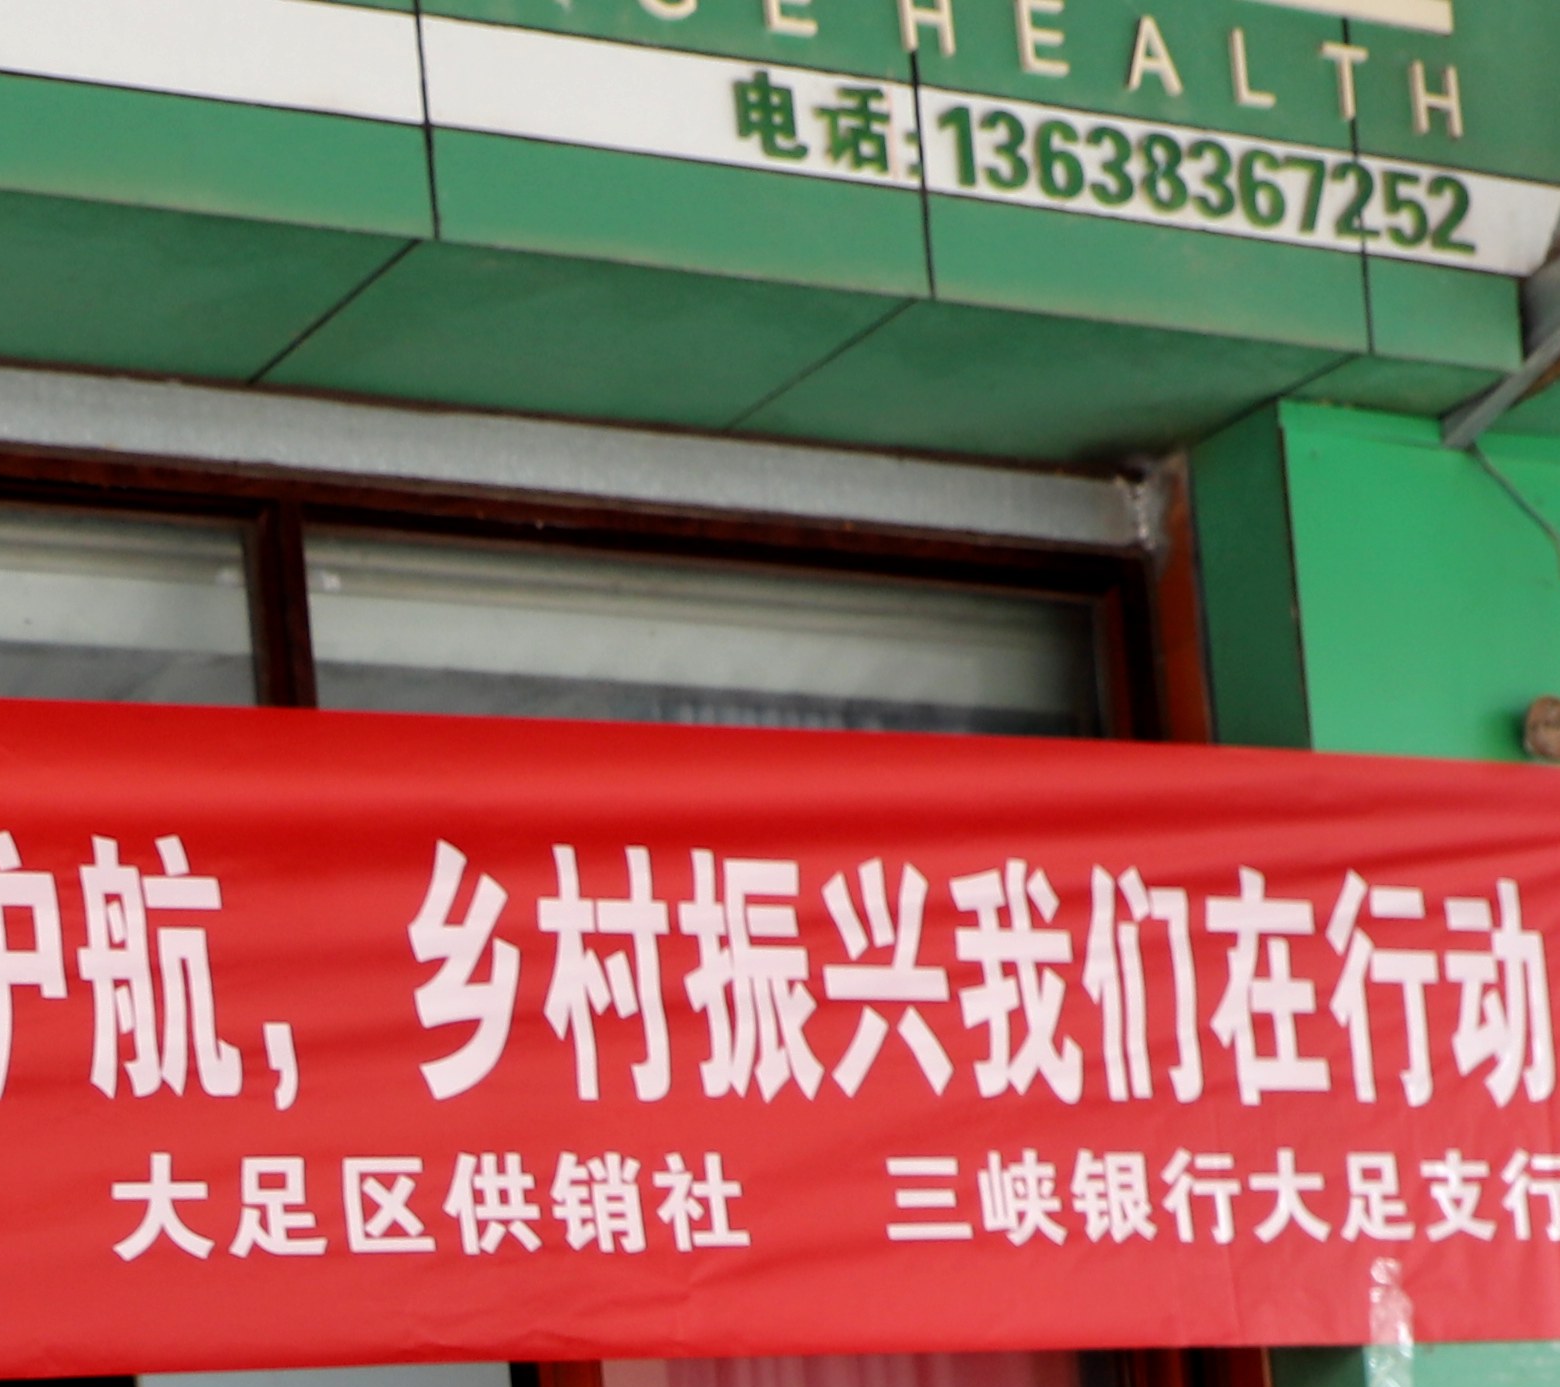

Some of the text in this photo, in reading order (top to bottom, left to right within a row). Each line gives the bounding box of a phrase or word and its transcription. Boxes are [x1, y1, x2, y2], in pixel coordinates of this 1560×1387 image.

[898, 0, 1464, 139] HEALTH
[111, 1150, 752, 1261] 大足区供销社
